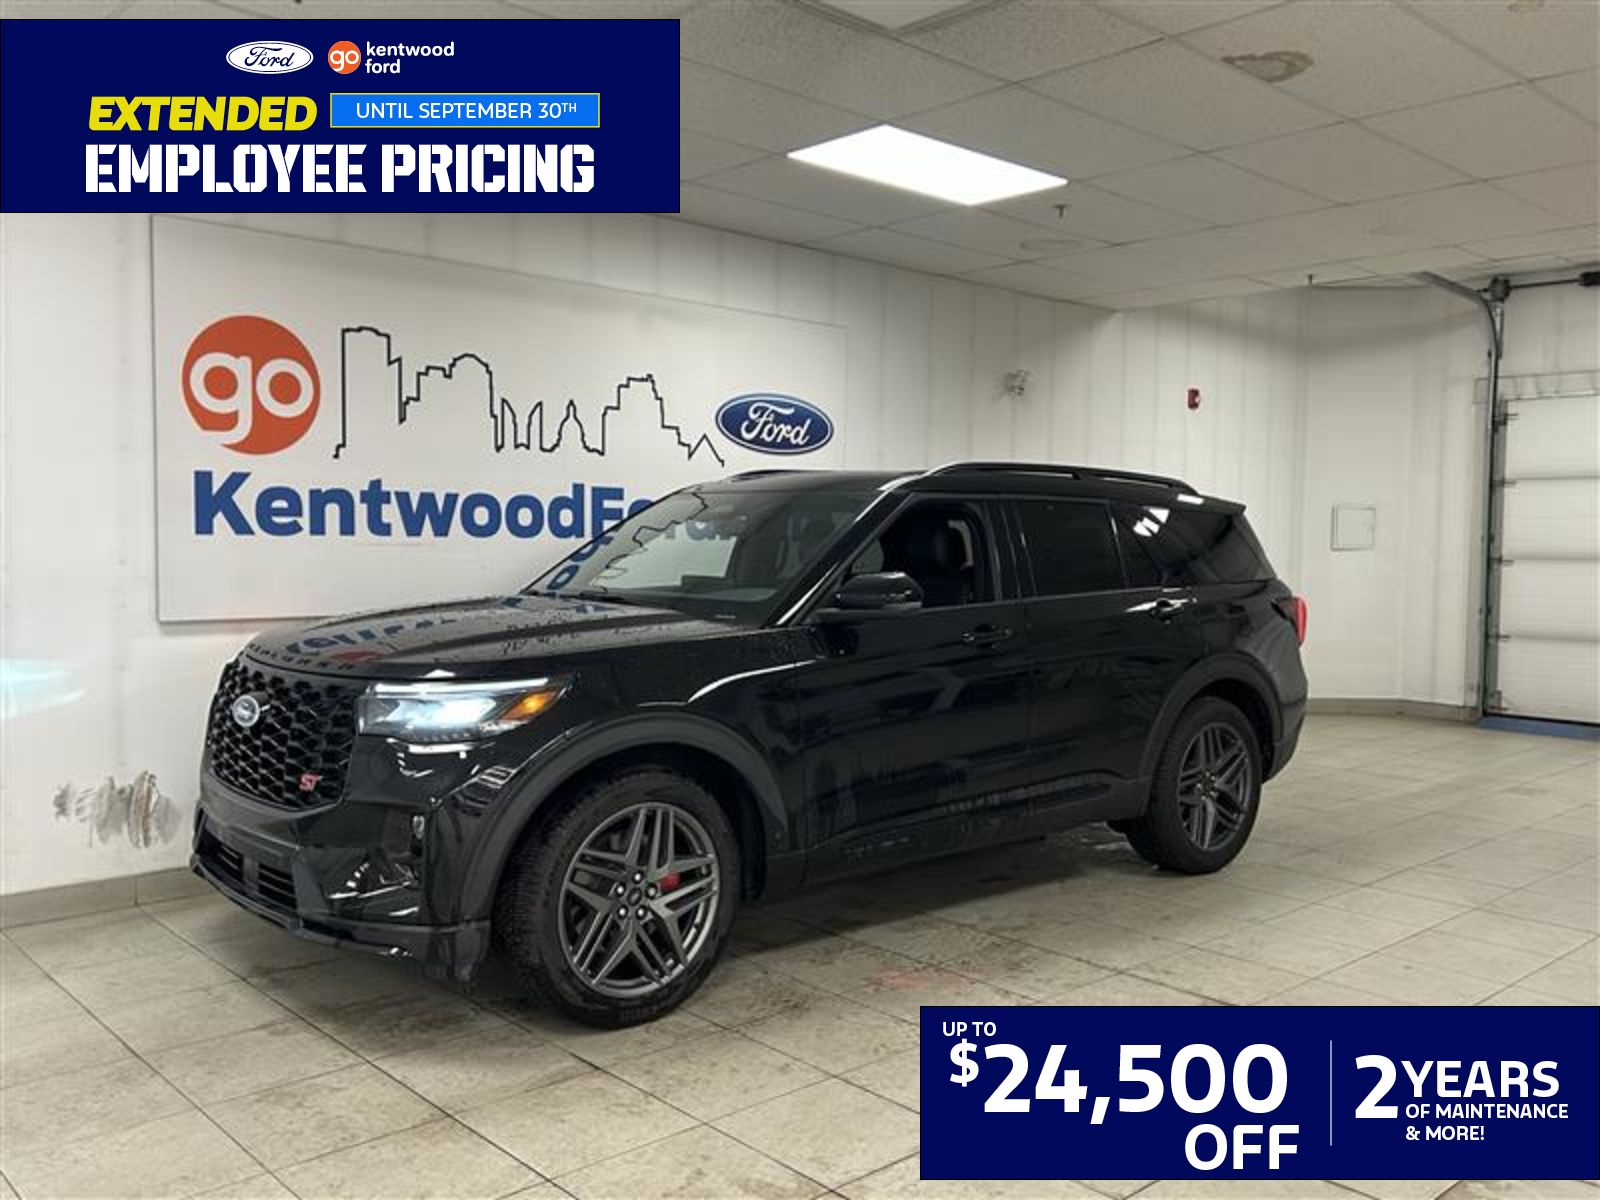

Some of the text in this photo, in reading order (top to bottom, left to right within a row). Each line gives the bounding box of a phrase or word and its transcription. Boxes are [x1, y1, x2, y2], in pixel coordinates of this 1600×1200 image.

[189, 352, 315, 444] go
[741, 402, 811, 445] Ford
[193, 470, 725, 541] KentwoodF
[299, 773, 323, 792] ST
